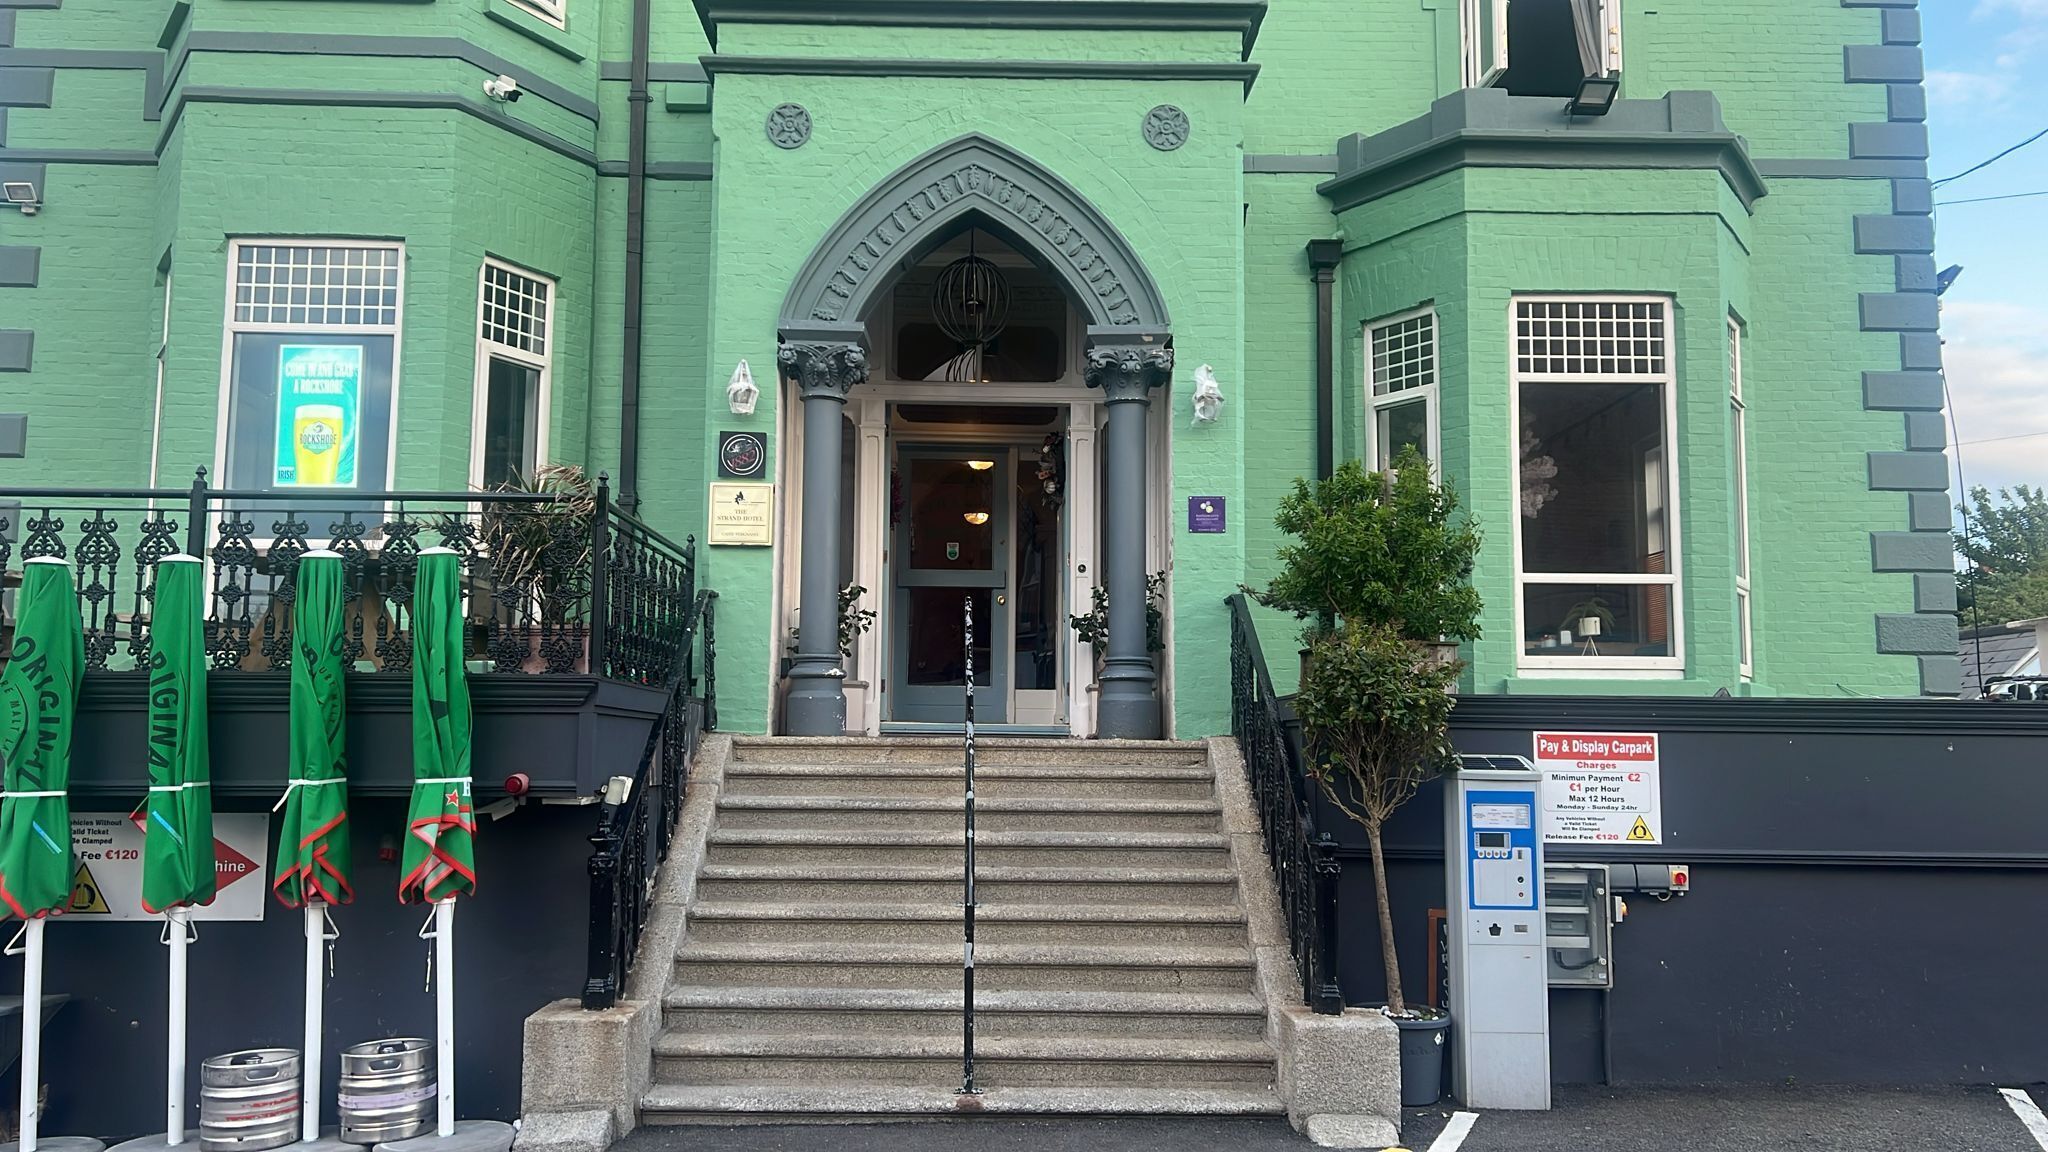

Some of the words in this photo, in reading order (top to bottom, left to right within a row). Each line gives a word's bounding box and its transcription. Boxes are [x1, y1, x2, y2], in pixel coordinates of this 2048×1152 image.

[300, 433, 337, 445] ROCKSHORE
[731, 449, 756, 470] 1882
[278, 470, 294, 479] IRISH
[1540, 739, 1559, 756] Pay
[1561, 740, 1569, 752] &
[1572, 740, 1610, 756] Display
[1611, 740, 1653, 757] Carpark
[1576, 761, 1617, 770] Charges
[1588, 774, 1624, 783] Payment
[1627, 773, 1641, 782] €2
[1569, 782, 1582, 792] €1
[1584, 786, 1598, 794] per
[1600, 785, 1621, 793] Hour
[1600, 795, 1625, 803] Hours
[81, 837, 113, 845] Clamped
[80, 851, 101, 860] Fee
[105, 849, 139, 860] €120
